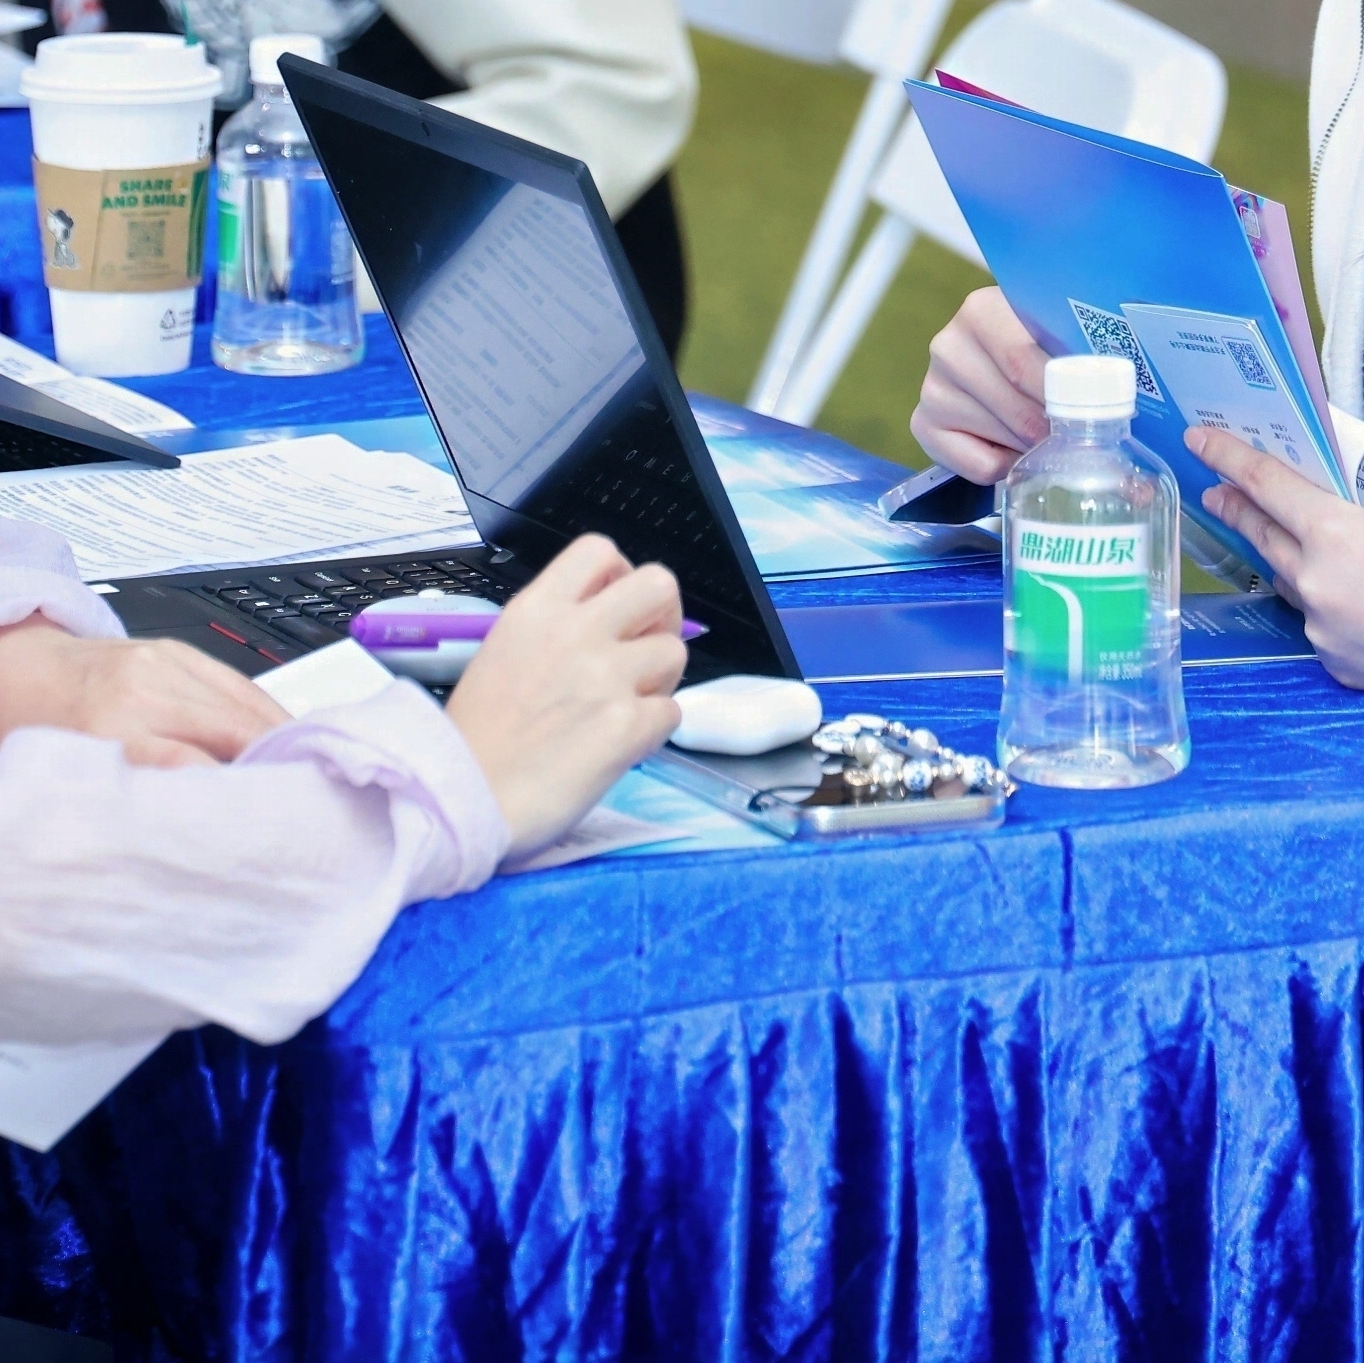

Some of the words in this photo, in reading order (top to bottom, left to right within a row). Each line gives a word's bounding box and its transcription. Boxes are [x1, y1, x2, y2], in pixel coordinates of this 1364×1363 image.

[120, 179, 172, 192] SHARE
[101, 197, 138, 209] AND
[143, 194, 185, 207] SMILE
[1020, 532, 1135, 565] 鼎湖山泉
